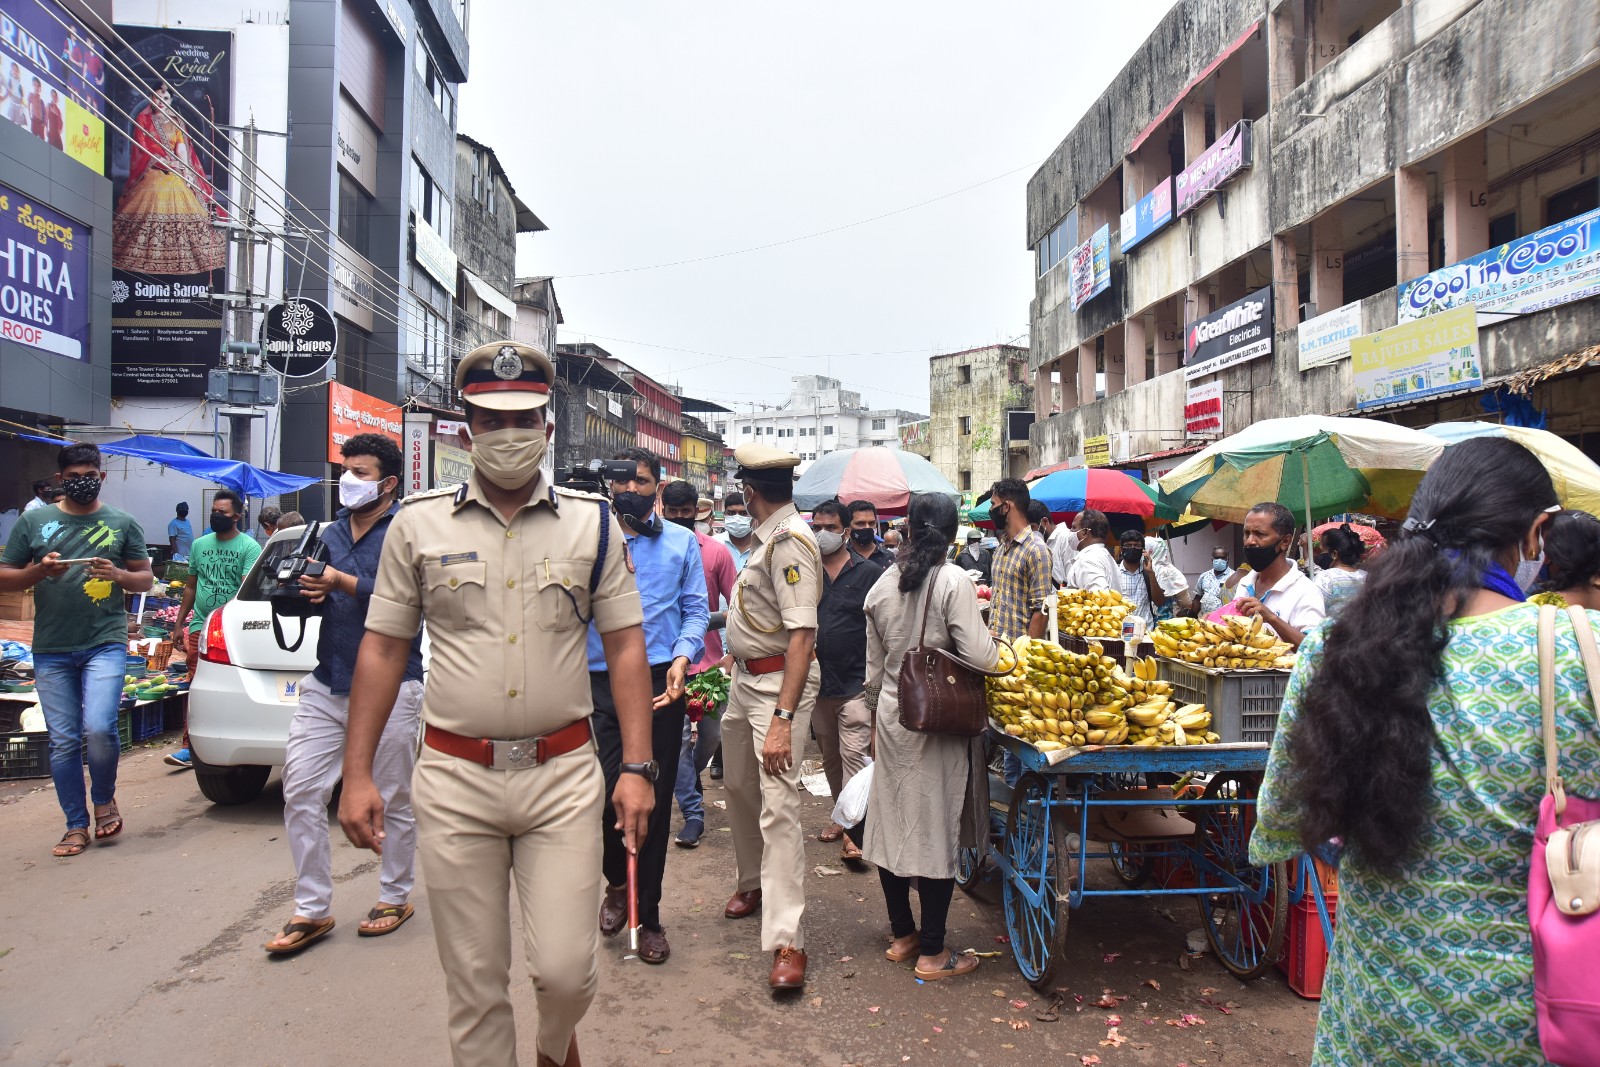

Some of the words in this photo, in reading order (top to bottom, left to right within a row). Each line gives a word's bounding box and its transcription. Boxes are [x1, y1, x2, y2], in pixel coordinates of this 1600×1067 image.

[174, 49, 210, 59] wedding
[1320, 45, 1336, 58] L3
[163, 50, 226, 86] Royal
[193, 57, 201, 65] A
[1469, 190, 1487, 207] L6
[1409, 268, 1471, 309] Cool
[1505, 221, 1591, 275] Cool
[135, 281, 171, 298] Sapna
[1458, 286, 1498, 306] CASUAL
[1501, 283, 1508, 292] &
[1512, 266, 1560, 289] SPORTS
[1496, 294, 1519, 305] TRACK
[1520, 286, 1544, 297] PANTS
[1545, 278, 1565, 289] TOPS
[1520, 301, 1548, 315] WHOLE
[1548, 294, 1570, 307] SALE
[1198, 301, 1263, 343] GreatWhite
[3, 320, 43, 346] ROOF
[157, 329, 184, 337] Readymade
[1164, 331, 1176, 341] L3
[1229, 325, 1261, 346] Electricals
[296, 338, 332, 352] Sarees
[1242, 345, 1260, 358] ELECTRIC
[1361, 339, 1421, 366] RAJVEER
[1424, 322, 1472, 349] SALES
[1113, 354, 1124, 363] L2
[215, 549, 241, 559] MANY
[199, 563, 238, 581] SMILES
